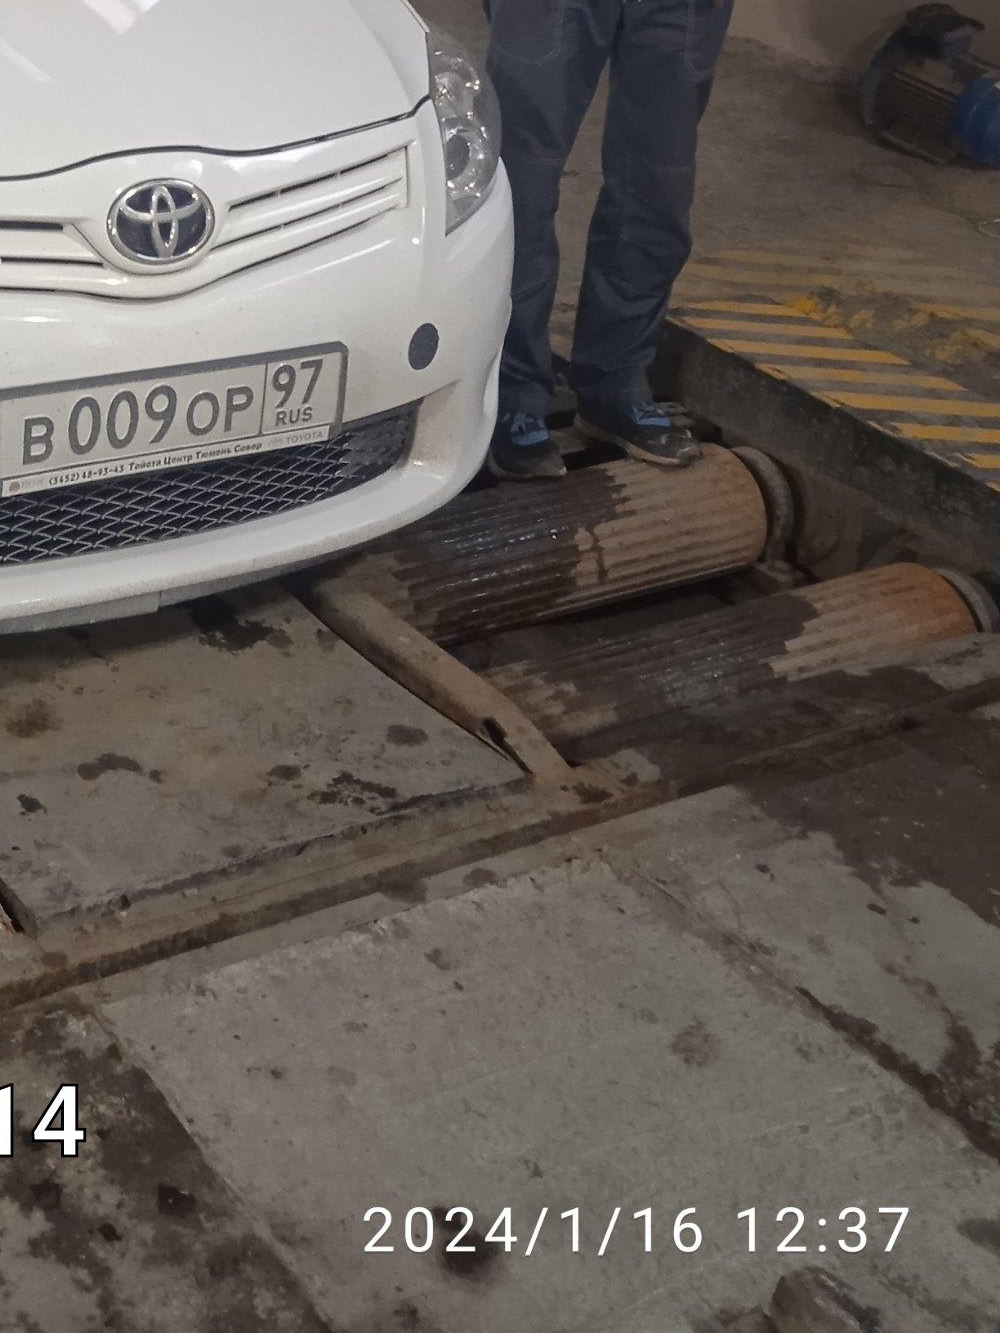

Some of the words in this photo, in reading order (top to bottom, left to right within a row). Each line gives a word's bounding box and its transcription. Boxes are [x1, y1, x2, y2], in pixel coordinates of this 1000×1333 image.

[272, 358, 323, 409] 97
[275, 406, 313, 427] RUS
[285, 430, 324, 444] TOYOTA
